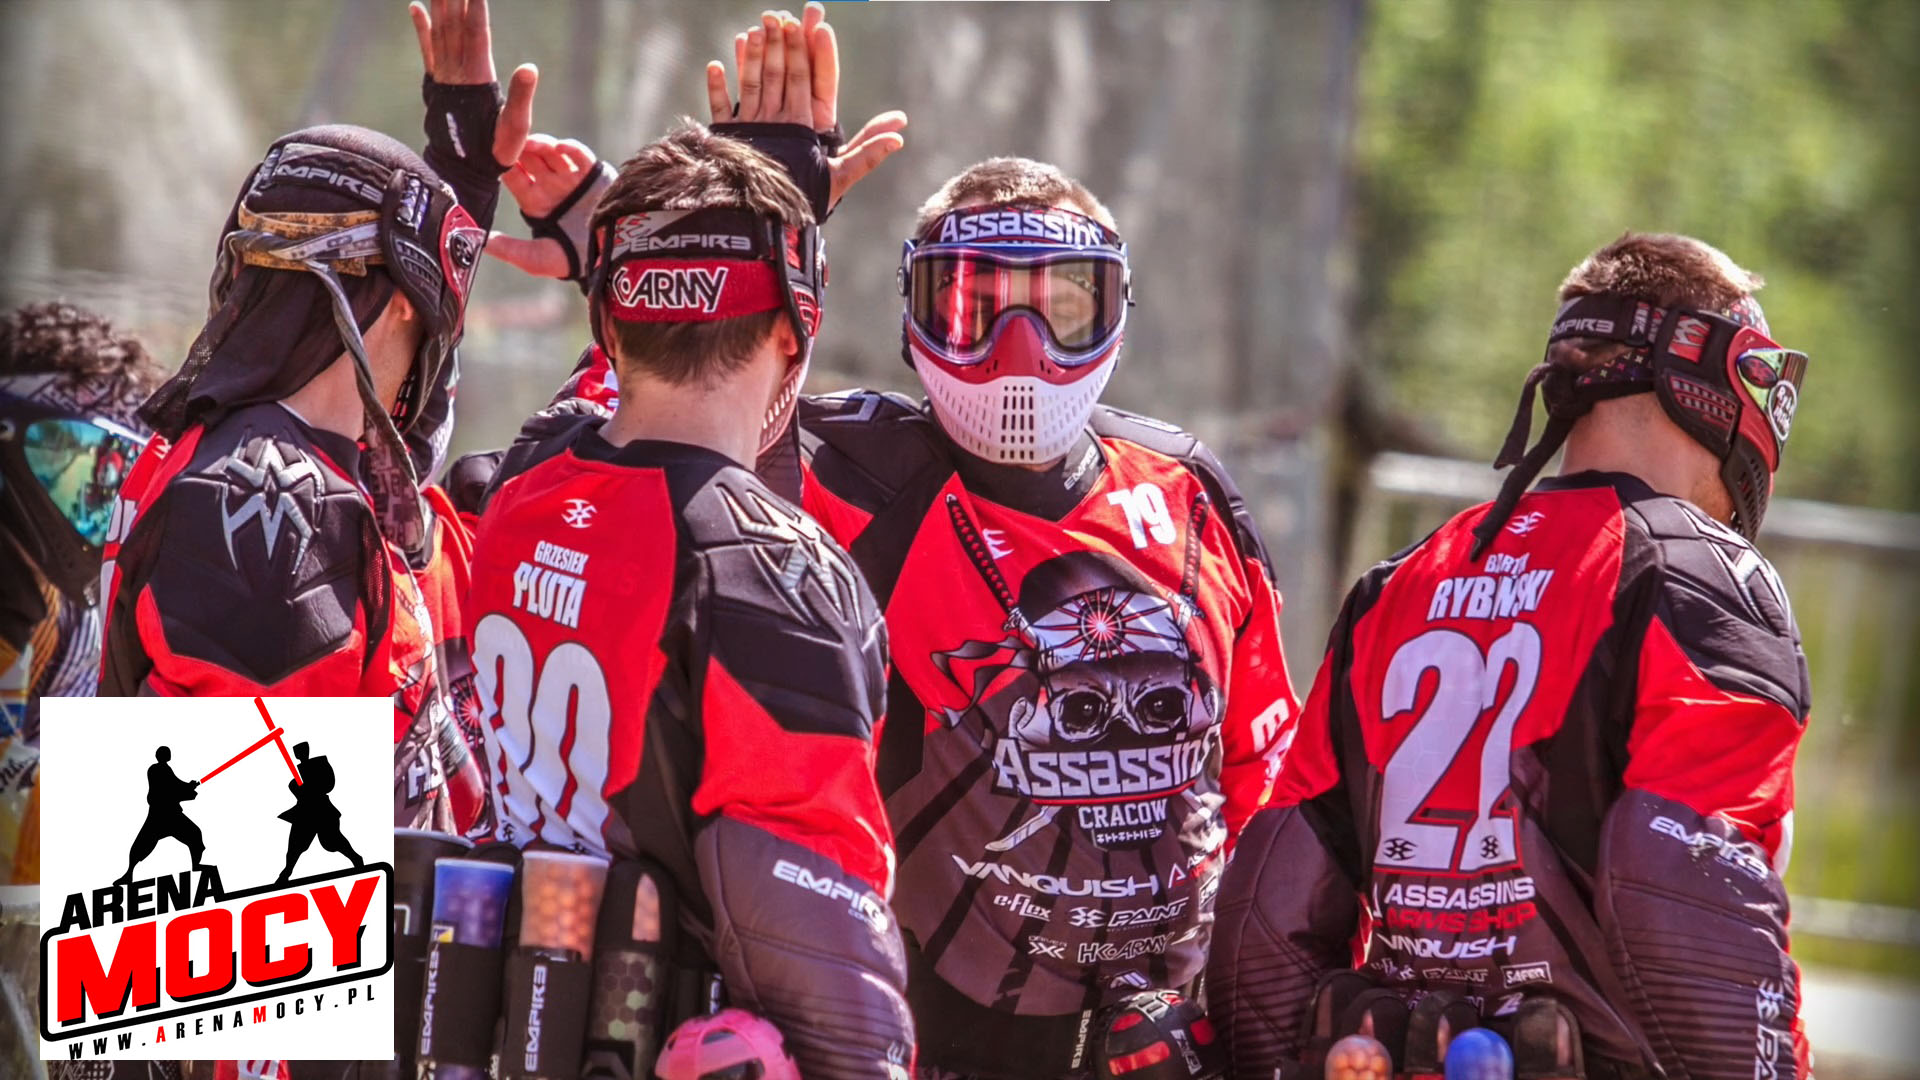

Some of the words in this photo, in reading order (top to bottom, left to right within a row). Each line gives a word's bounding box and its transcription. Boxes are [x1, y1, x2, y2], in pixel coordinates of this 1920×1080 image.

[1106, 482, 1177, 550] 79
[533, 540, 590, 576] GRZESIEK
[513, 561, 588, 630] PLUTA
[1373, 620, 1542, 872] 22
[1078, 799, 1168, 829] CRACOW
[951, 855, 1160, 898] VANQUISH
[1384, 877, 1537, 911] ASSASSINS
[1107, 896, 1190, 928] PAINT
[1387, 906, 1467, 934] ARMS
[1468, 901, 1538, 934] SHOP
[1377, 932, 1517, 960] VANQUISH
